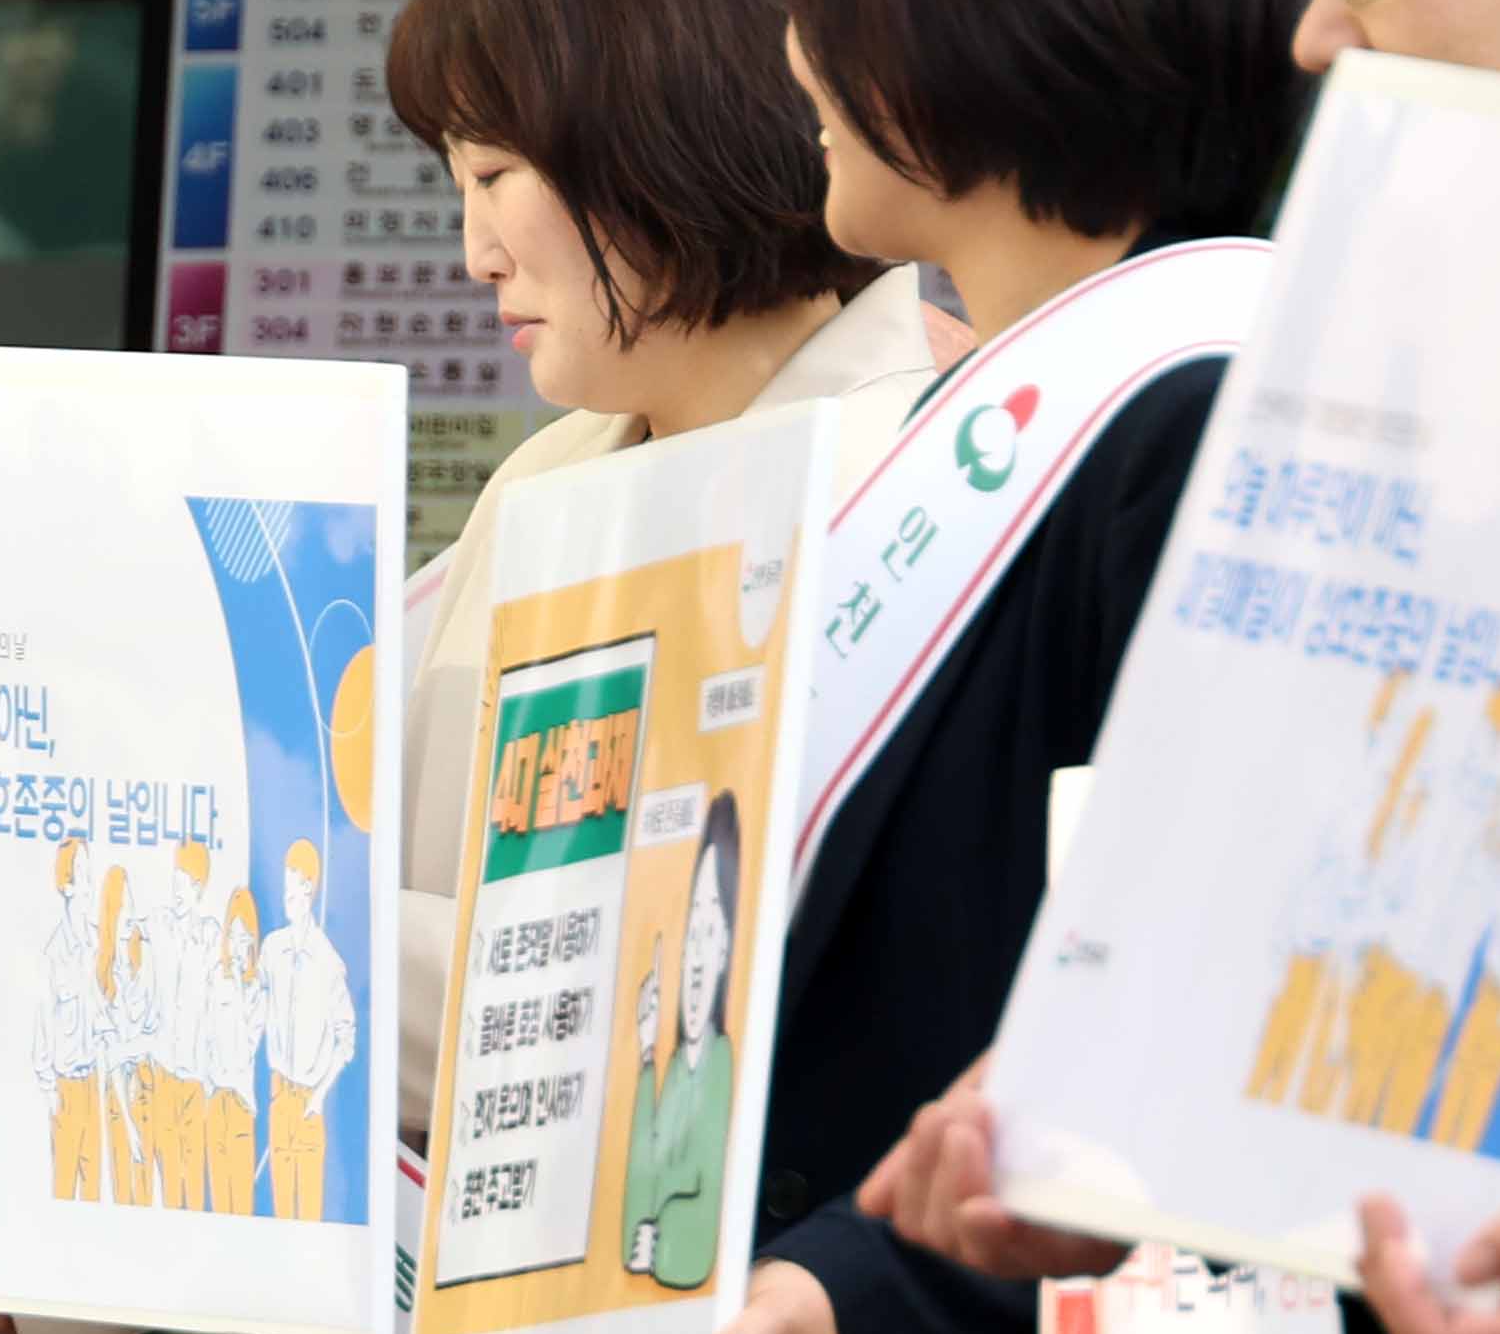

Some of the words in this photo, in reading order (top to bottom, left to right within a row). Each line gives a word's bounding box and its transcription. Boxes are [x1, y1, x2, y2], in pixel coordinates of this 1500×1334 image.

[268, 16, 328, 45] 504
[265, 69, 325, 98] 401
[261, 116, 321, 146] 403
[181, 140, 232, 171] 4F
[256, 213, 317, 243] 410
[252, 265, 312, 295] 301
[170, 315, 223, 347] 3F
[249, 314, 311, 345] 304
[105, 777, 224, 851] 날입니다.
